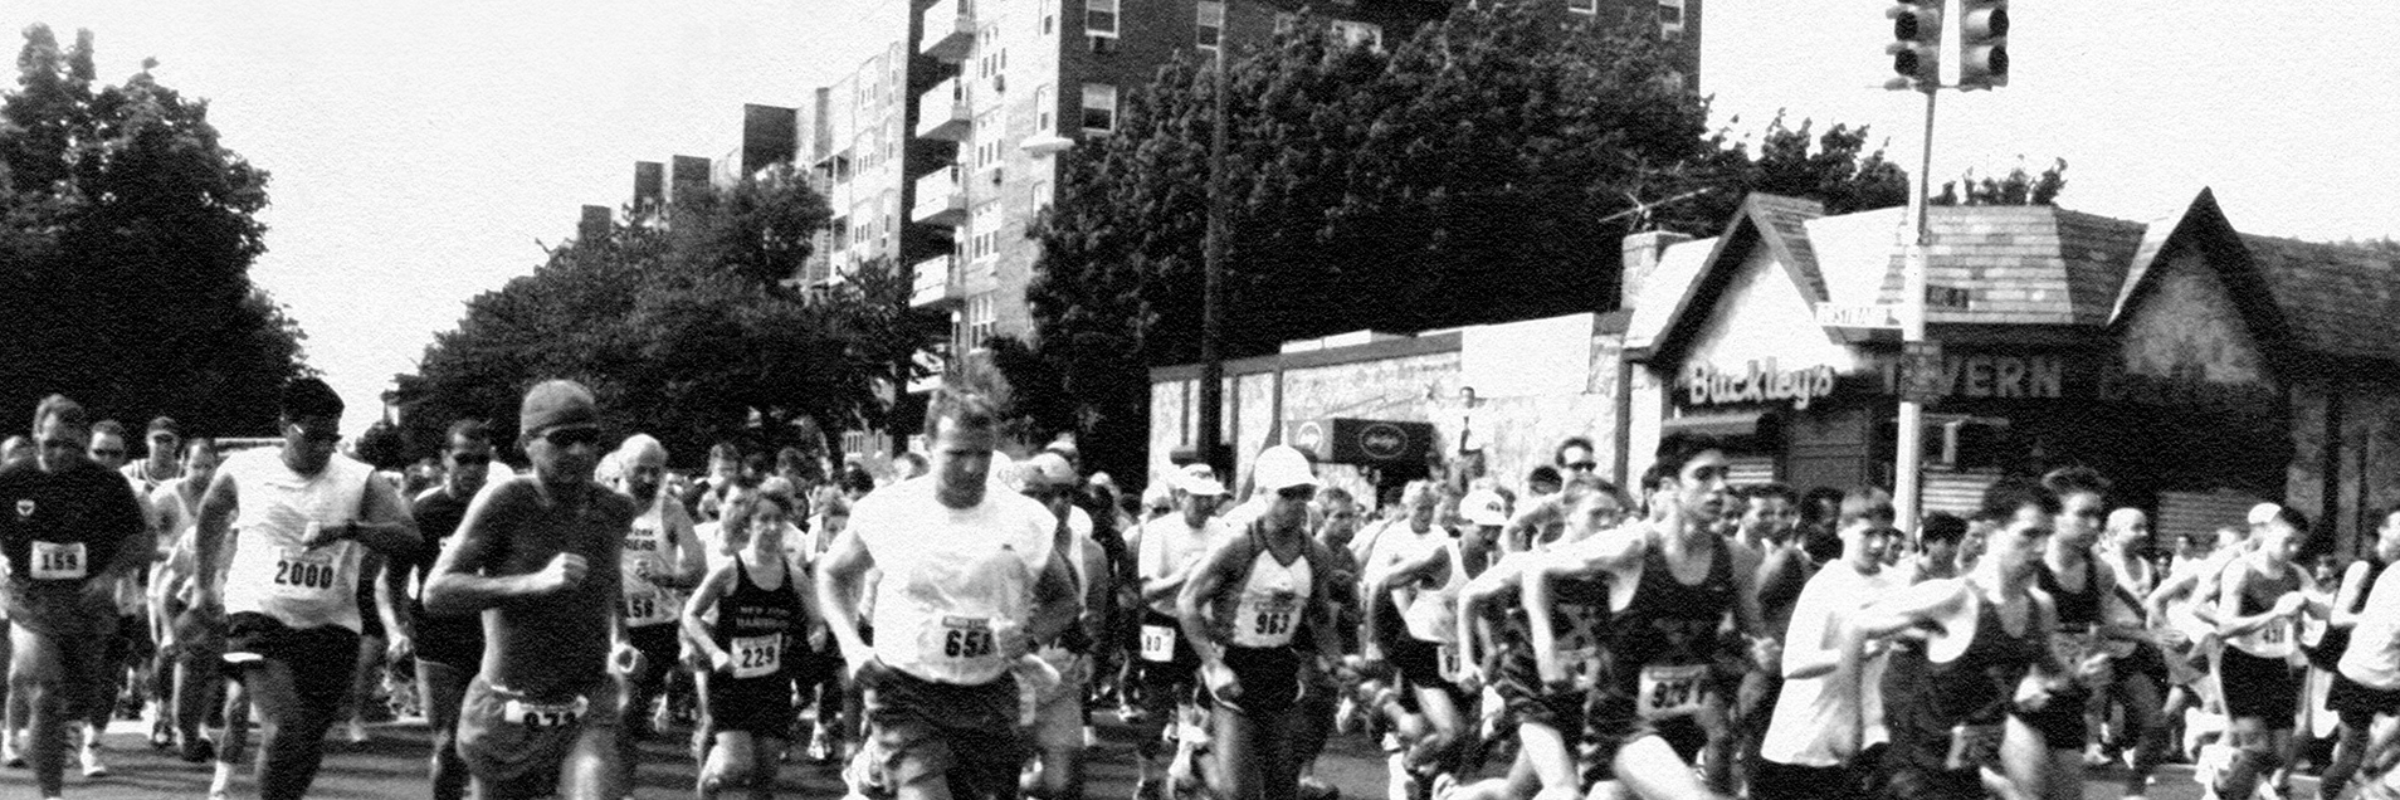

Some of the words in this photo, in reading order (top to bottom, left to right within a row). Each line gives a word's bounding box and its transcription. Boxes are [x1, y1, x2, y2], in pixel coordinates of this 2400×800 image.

[1688, 356, 1834, 410] Buckley's
[1876, 355, 2062, 397] TVERN
[274, 560, 334, 590] 2000
[1255, 612, 1291, 635] 963
[742, 646, 775, 668] 229
